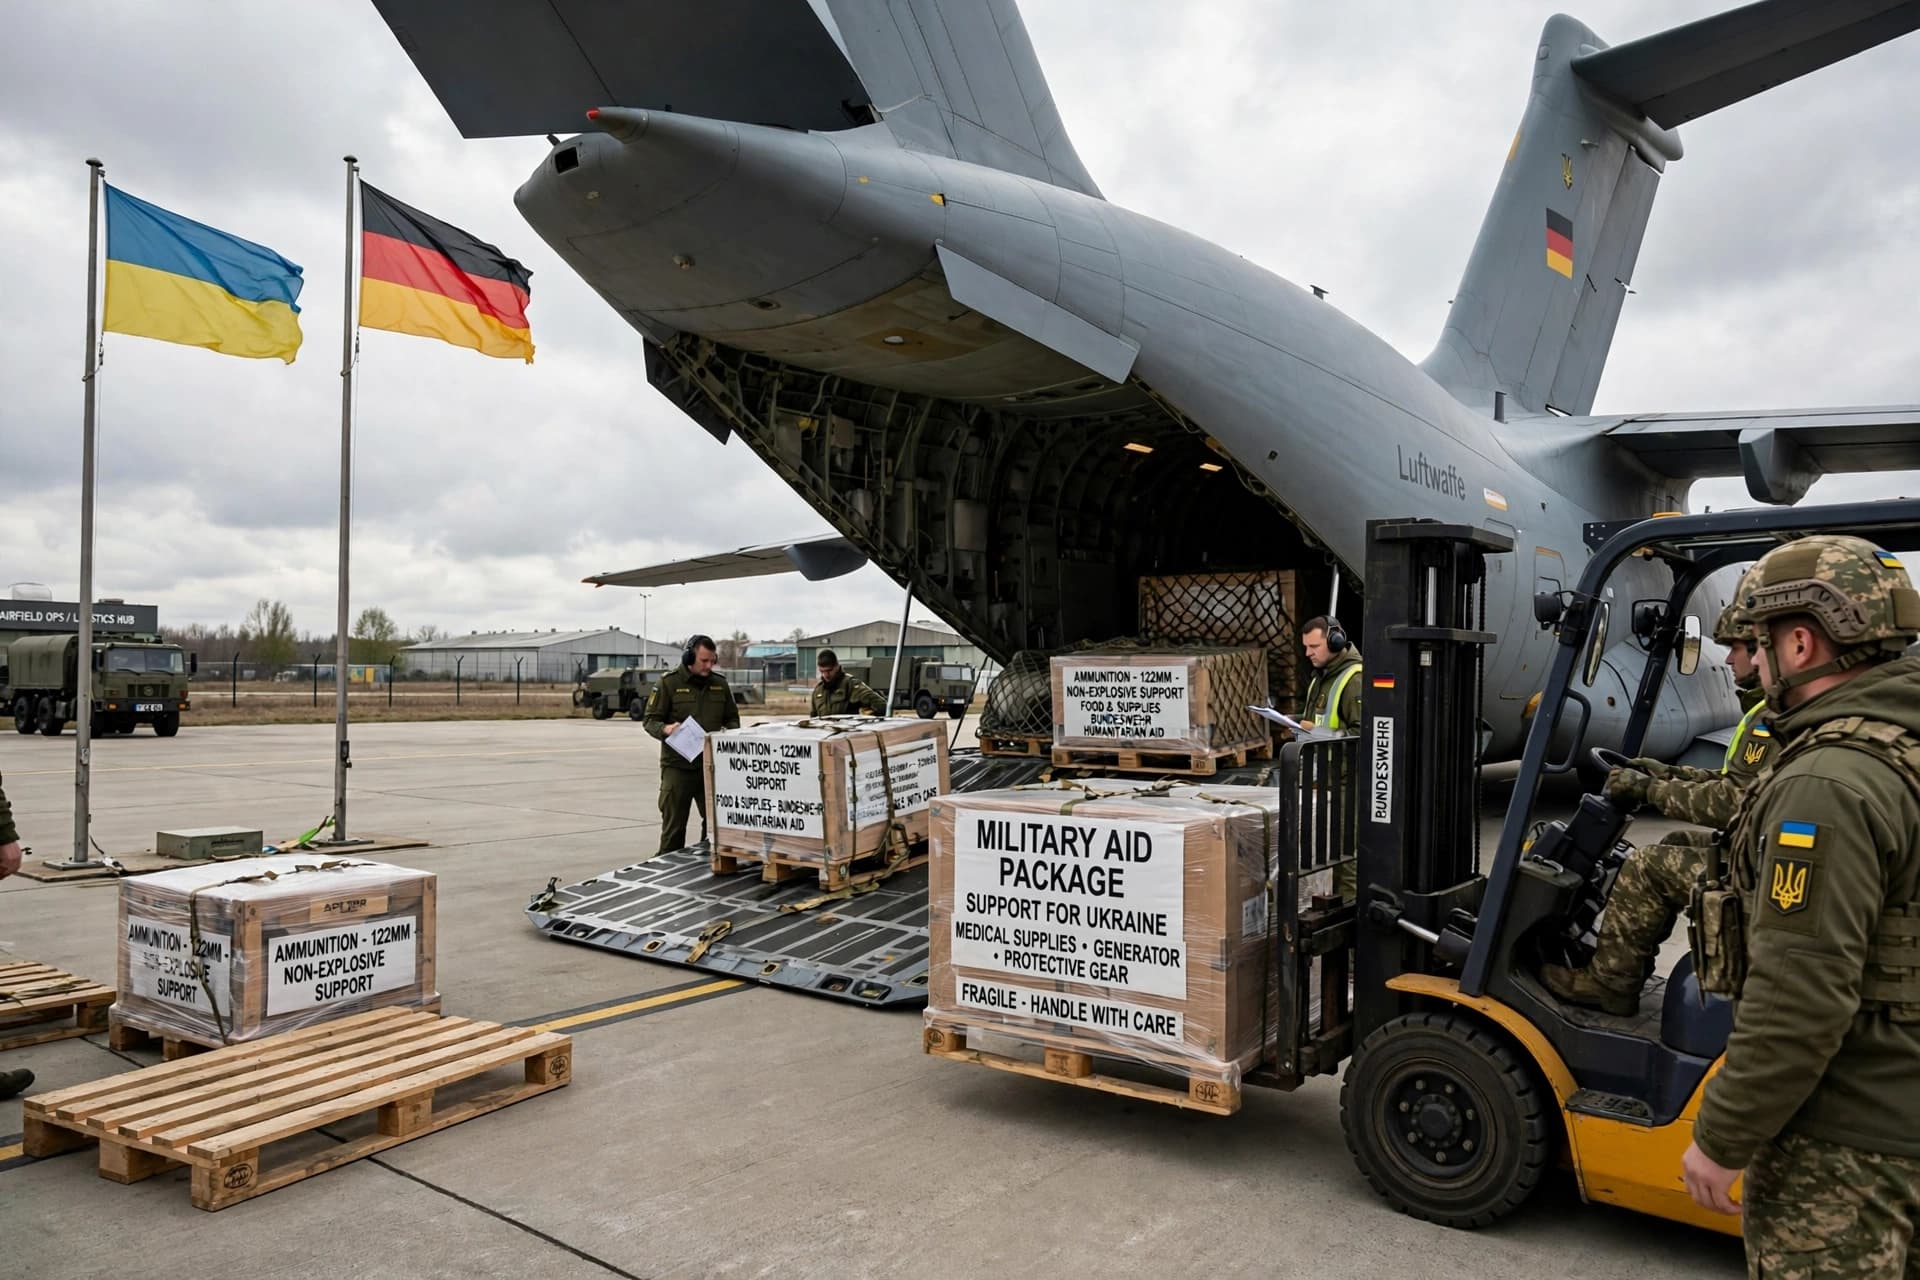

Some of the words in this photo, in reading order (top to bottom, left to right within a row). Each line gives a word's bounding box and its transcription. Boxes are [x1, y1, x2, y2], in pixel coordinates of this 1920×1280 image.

[1397, 444, 1466, 501] Luftwaffe
[45, 611, 65, 623] OPS
[73, 613, 115, 624] LSTICS
[117, 615, 135, 625] HUB
[1074, 671, 1131, 683] AMMUNITION
[1140, 671, 1172, 683] 122MM
[1066, 686, 1137, 698] NON-EXPLOSIVE
[1140, 686, 1184, 699] SUPPORT
[1081, 701, 1104, 712] FOOD
[1106, 701, 1113, 712] &
[1117, 701, 1161, 713] SUPPLIES
[1084, 726, 1147, 737] HUMANITARIAN
[1149, 727, 1165, 738] AID
[716, 741, 771, 756] AMMUNITION
[780, 744, 812, 759] 122MM
[729, 757, 801, 775] NON-EXPLOSIVE
[1375, 719, 1390, 819] BUNDESWEHR
[746, 775, 787, 791] SUPPORT
[727, 811, 788, 829] HUMANITARIAN
[790, 817, 805, 831] AID
[977, 819, 1097, 858] MILITARY
[1103, 829, 1153, 863] AID
[1000, 857, 1125, 898] PACKAGE
[966, 892, 1041, 920] SUPPORT
[1046, 901, 1081, 927] FOR
[1087, 906, 1167, 936] UKRAINE
[195, 938, 222, 963] 22MM
[274, 932, 359, 963] AMMUNITION
[371, 923, 411, 946] 122MM
[956, 921, 1010, 945] MEDICAL
[1013, 928, 1077, 953] SUPPLIES
[1094, 939, 1181, 968] GENERATOR
[284, 950, 385, 985] NON-EXPLOSIVE
[1004, 949, 1086, 977] PROTECTIVE
[1089, 961, 1129, 984] GEAR
[157, 978, 198, 1004] SUPPORT
[315, 974, 375, 1001] SUPPORT
[962, 983, 1017, 1009] FRAGILE
[1031, 994, 1087, 1022] HANDLE
[1092, 1004, 1128, 1029] WITH
[1133, 1011, 1176, 1036] CARE
